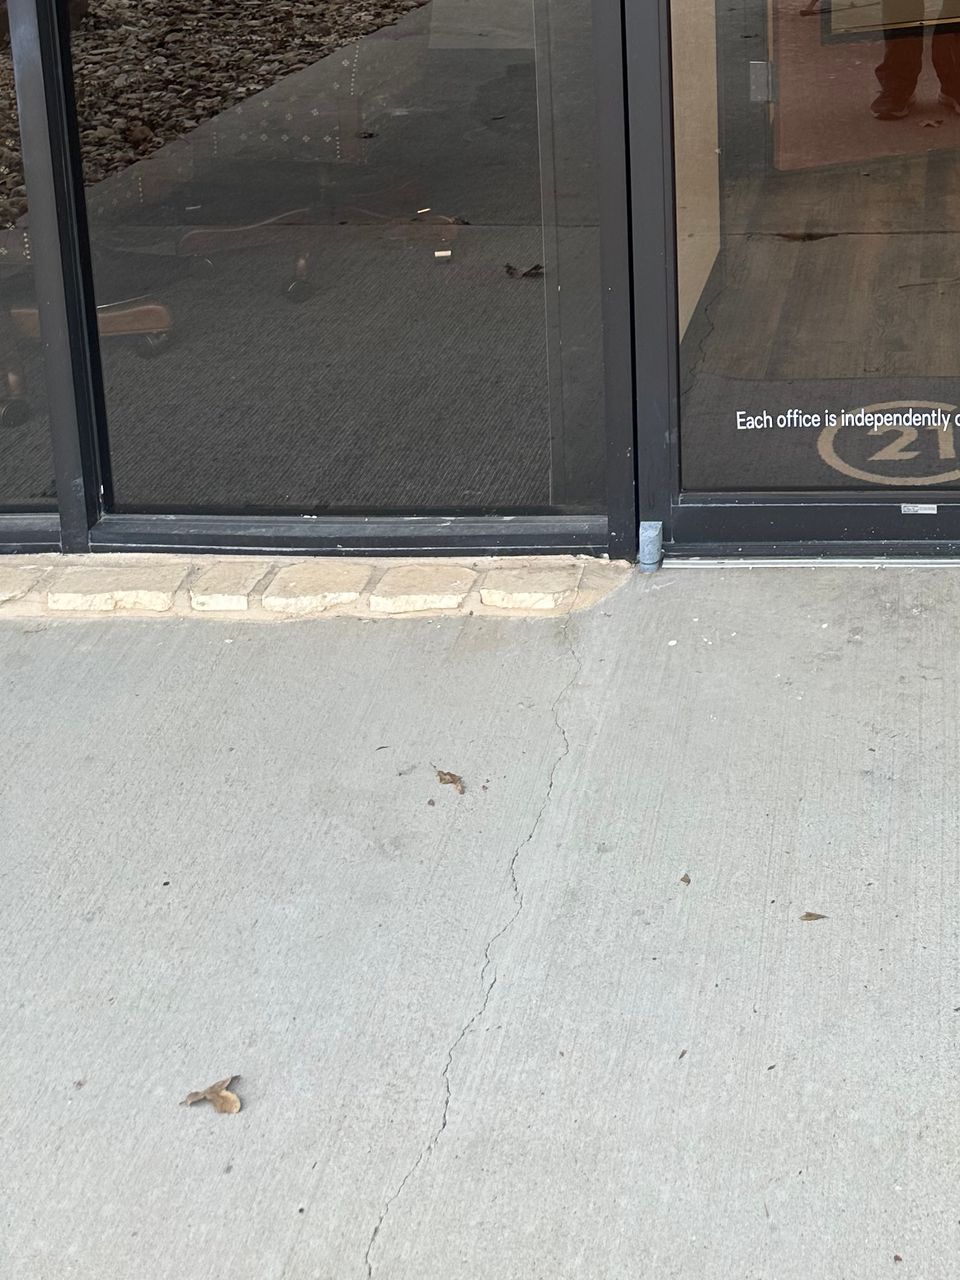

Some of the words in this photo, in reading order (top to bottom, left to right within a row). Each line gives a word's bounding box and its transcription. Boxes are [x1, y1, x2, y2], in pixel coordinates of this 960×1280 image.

[736, 410, 773, 430] Each
[776, 408, 821, 428] office
[825, 409, 837, 427] is
[841, 408, 951, 432] independently
